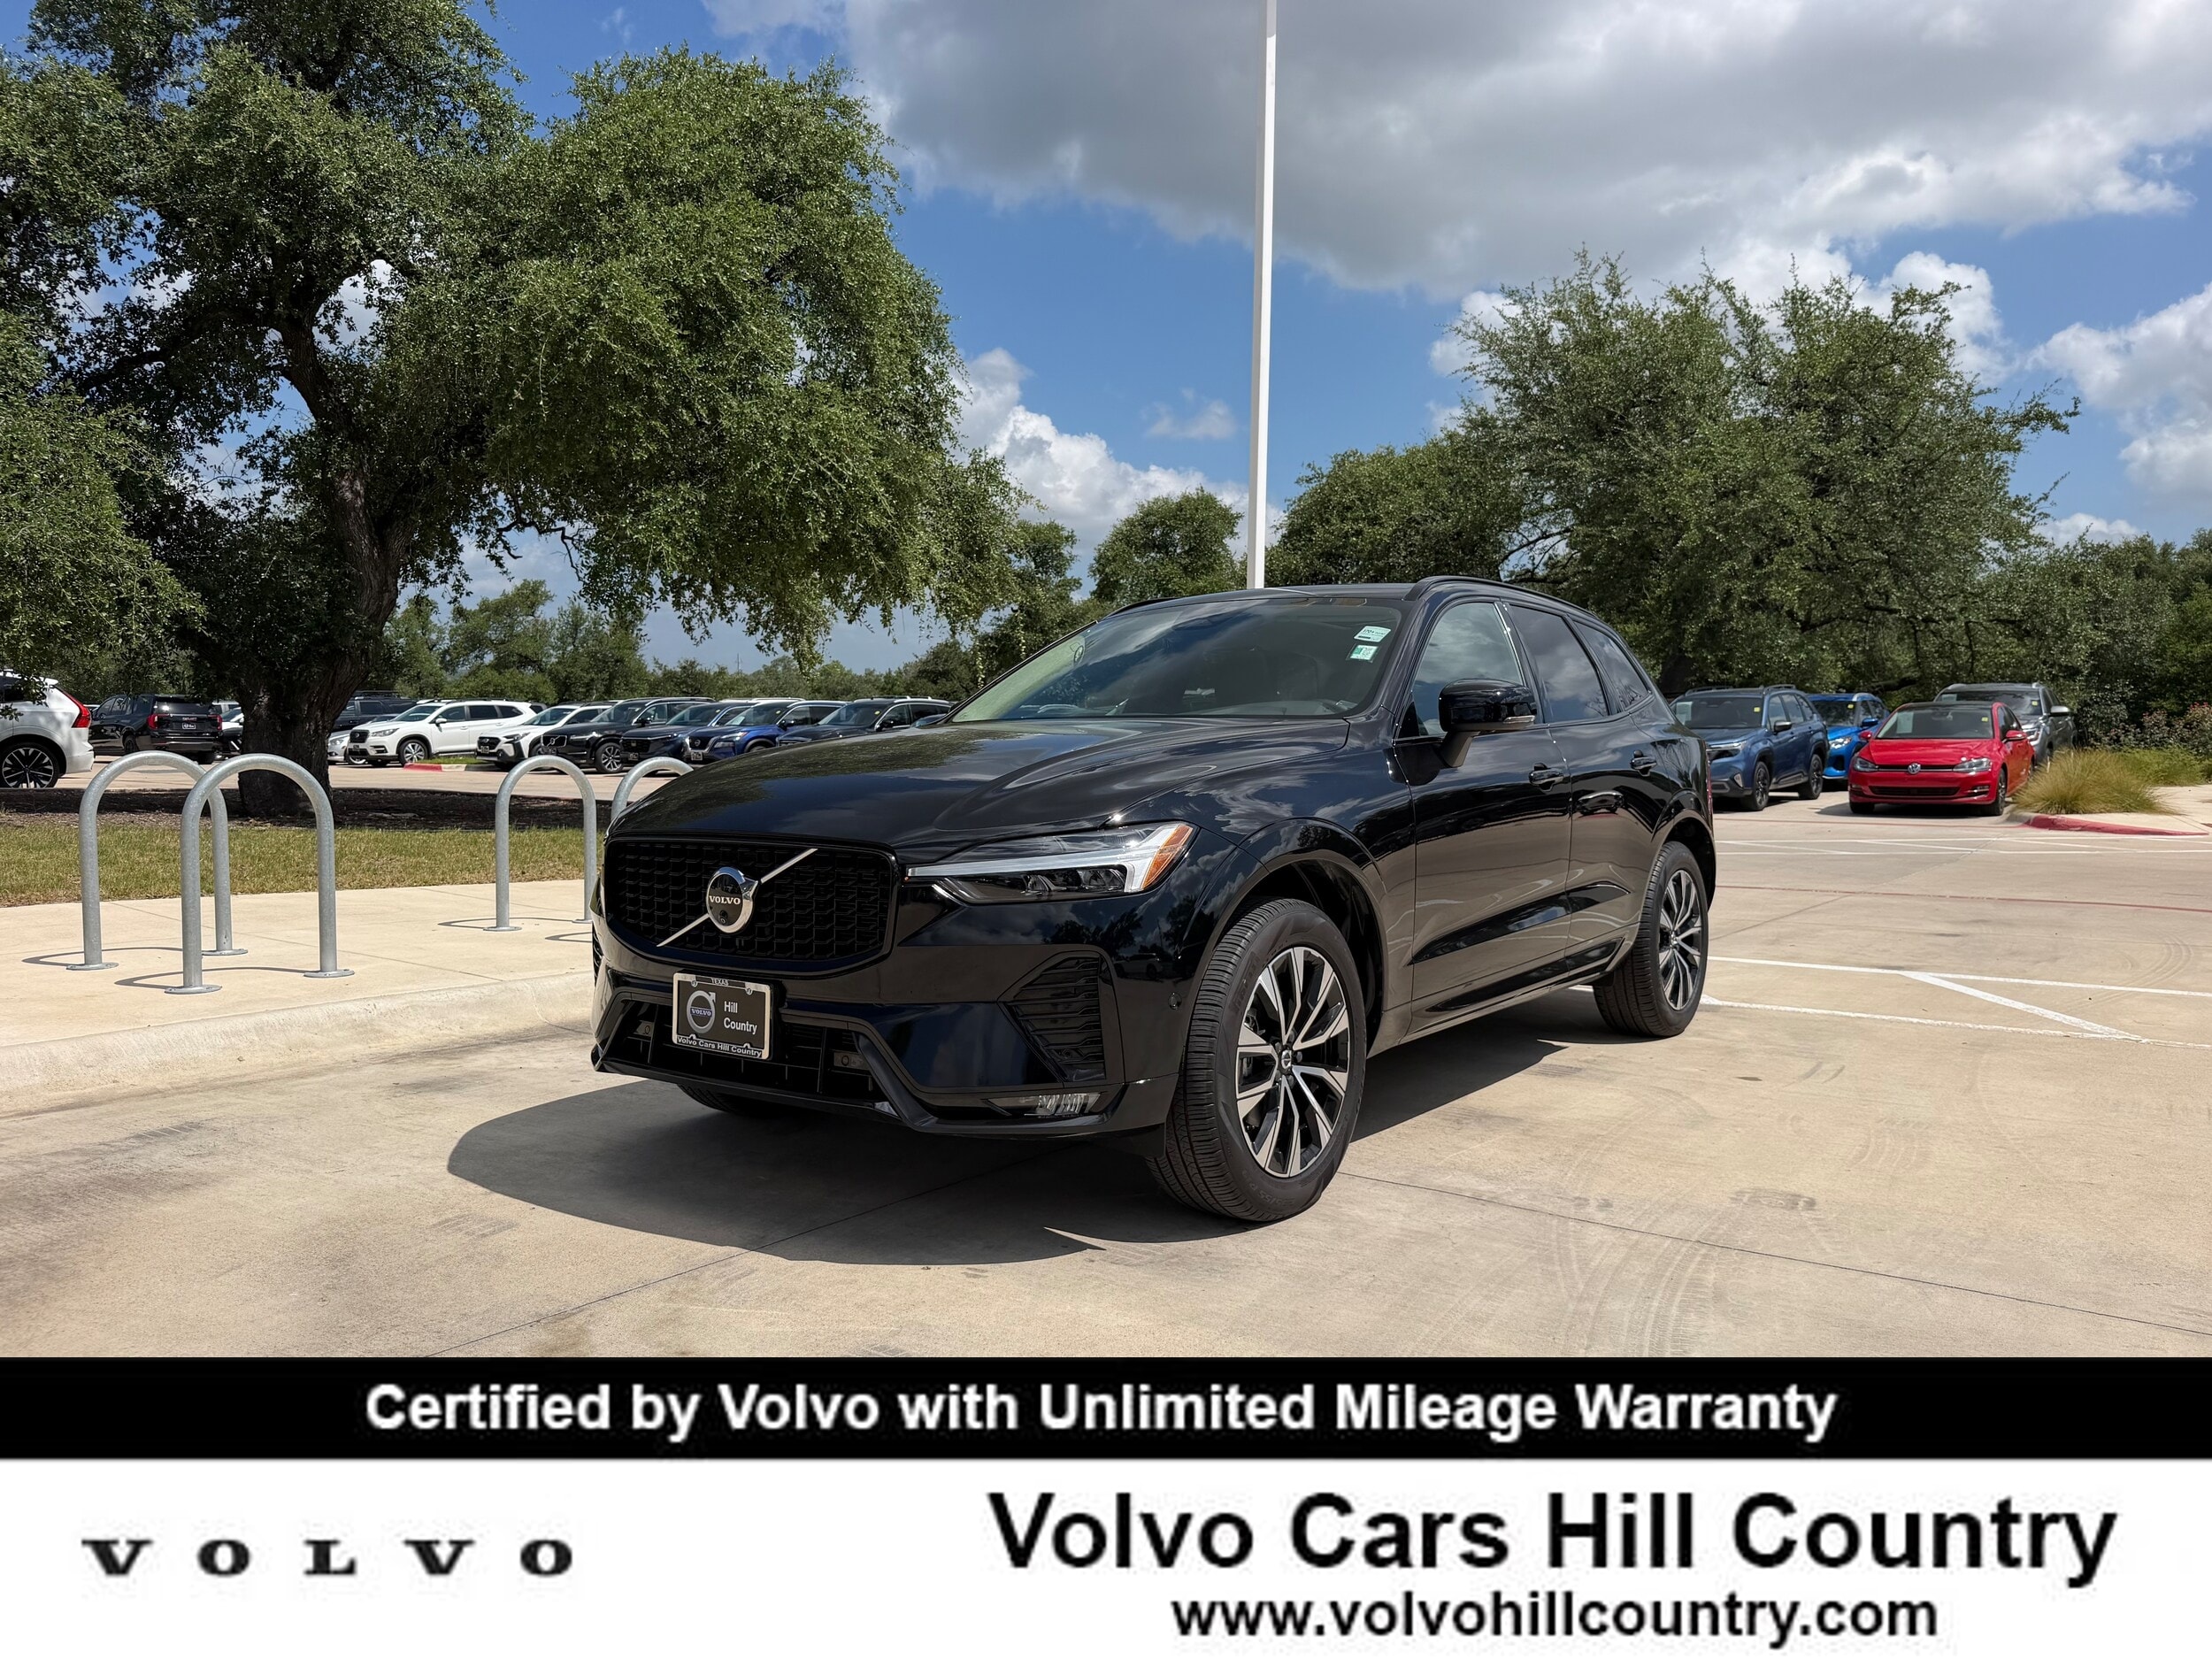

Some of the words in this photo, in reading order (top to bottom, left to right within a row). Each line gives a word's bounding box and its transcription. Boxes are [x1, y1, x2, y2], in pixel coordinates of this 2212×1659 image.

[709, 895, 741, 905] VOLVO
[710, 978, 729, 987] TEXAS
[724, 1001, 738, 1014] Hill
[723, 1017, 757, 1035] Country
[677, 1036, 697, 1046] Volvo
[698, 1041, 716, 1049] Cars
[717, 1043, 730, 1052] Hill
[731, 1045, 762, 1058] Country
